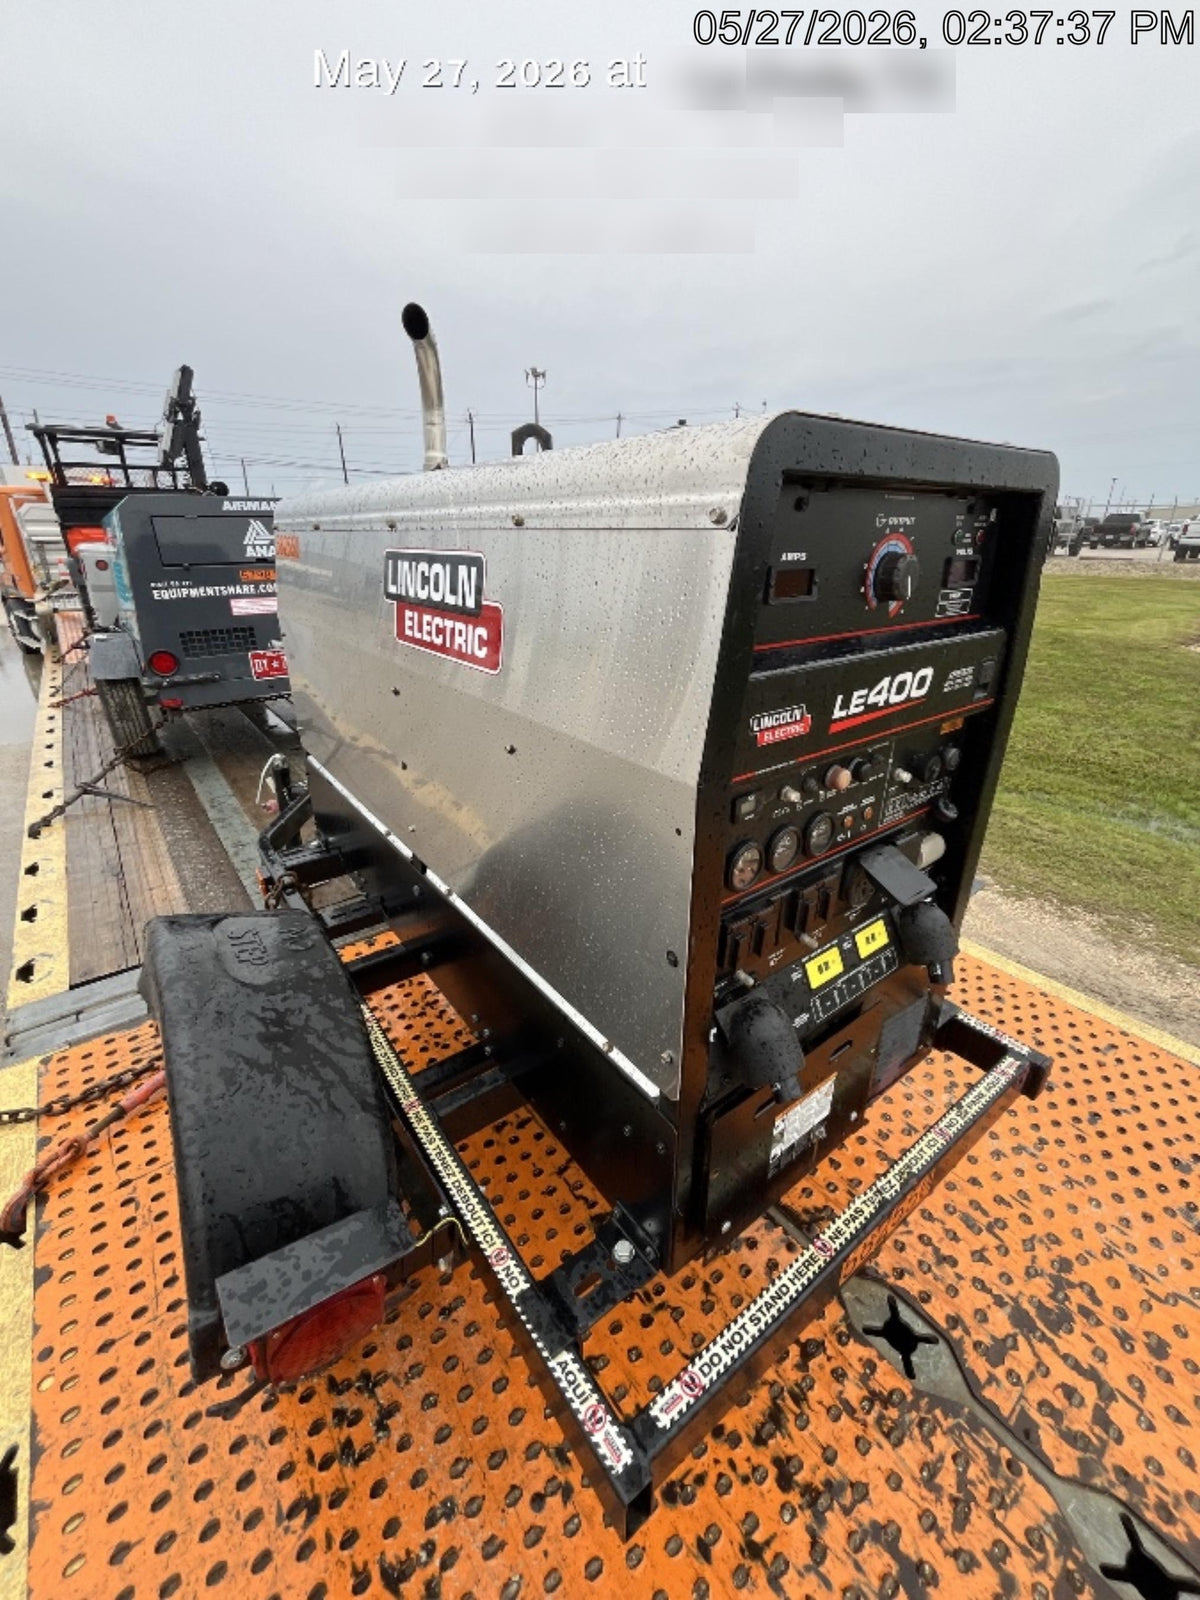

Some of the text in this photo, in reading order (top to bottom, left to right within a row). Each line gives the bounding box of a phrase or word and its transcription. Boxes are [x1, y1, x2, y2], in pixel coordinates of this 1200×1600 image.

[387, 559, 477, 609] LINCOLN
[404, 609, 489, 658] ELECTRIC
[832, 666, 934, 719] LE400
[753, 708, 801, 731] LINCOLN
[420, 1125, 436, 1145] PAS
[432, 1144, 457, 1178] TENEZ
[452, 1180, 486, 1227] DEBOUT
[481, 1229, 496, 1248] ICI
[502, 1265, 520, 1289] NO
[698, 1352, 723, 1378] DO
[719, 1322, 751, 1355] NOT
[748, 1284, 790, 1327] STAND
[787, 1252, 820, 1286] HERE
[828, 1226, 847, 1243] NE
[842, 1207, 865, 1228] PAS
[924, 1137, 938, 1151] ICI
